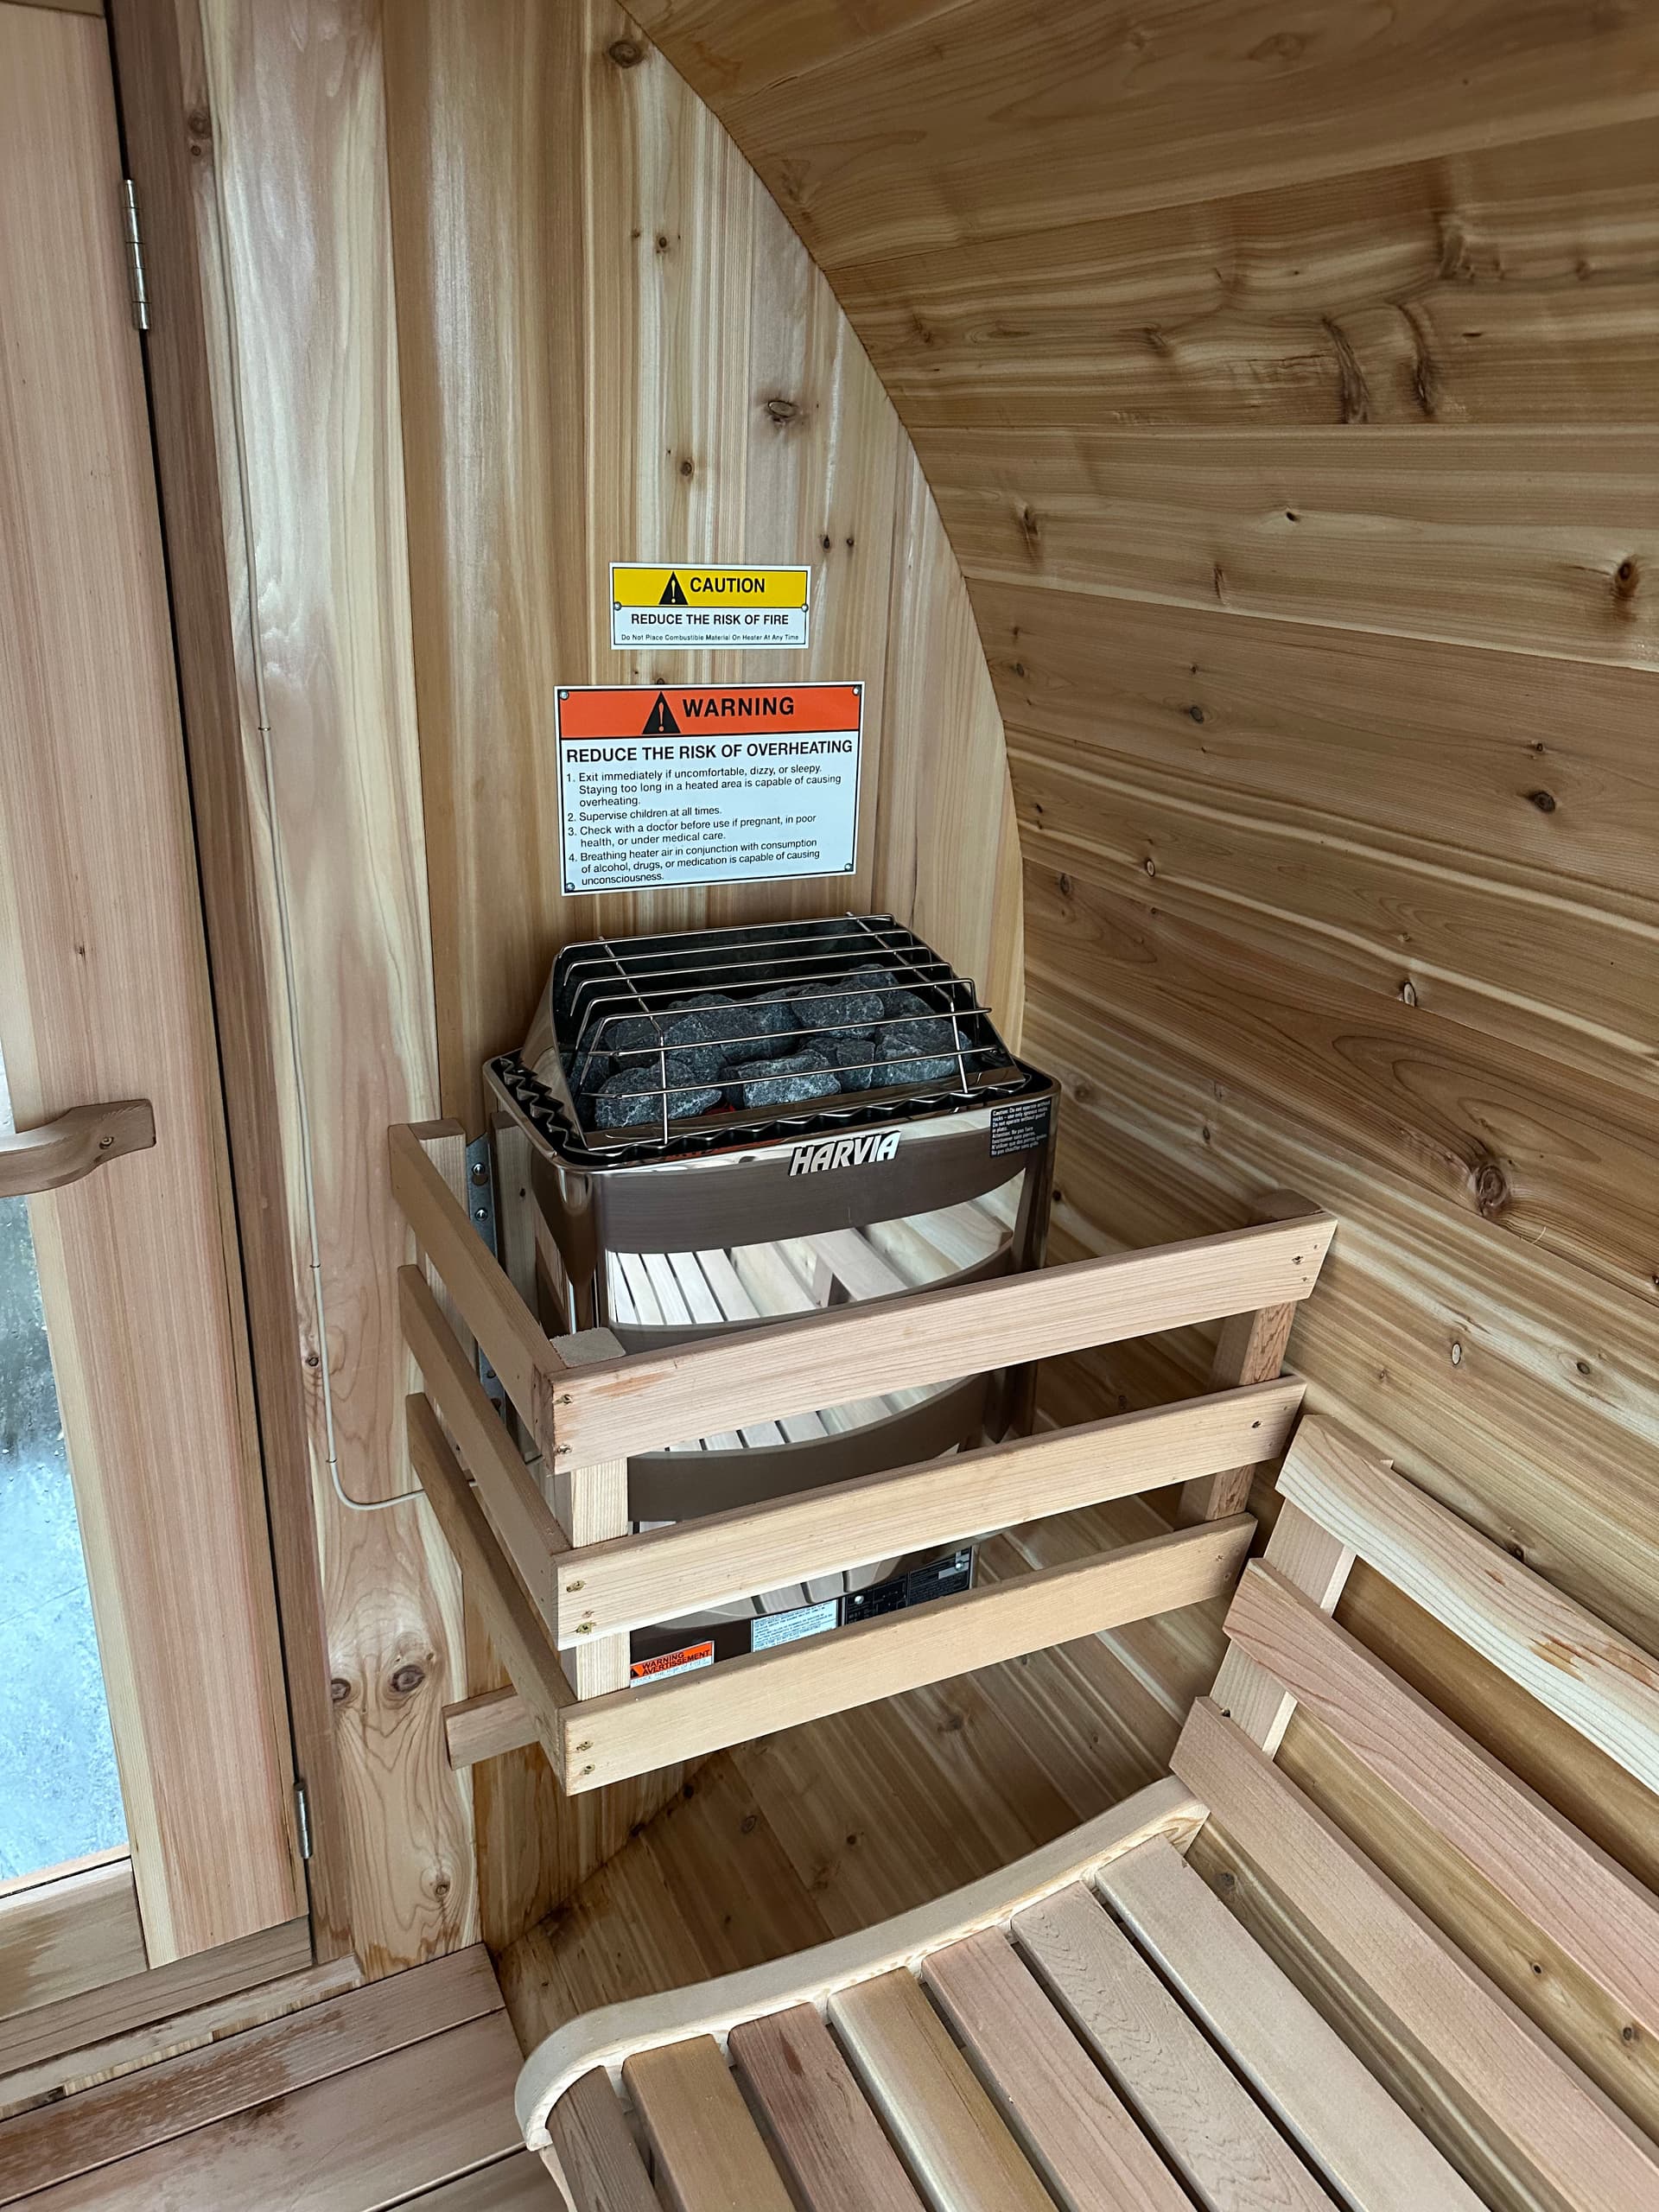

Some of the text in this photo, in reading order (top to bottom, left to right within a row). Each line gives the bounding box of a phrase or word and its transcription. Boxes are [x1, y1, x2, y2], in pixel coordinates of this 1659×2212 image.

[690, 577, 766, 594] CAUTION
[631, 614, 789, 625] REDUCE THE RISK OF FIRE
[683, 696, 795, 717] WARNING
[566, 740, 853, 763] REDUCE THE RISK OF OVERHEATING
[566, 764, 822, 782] 1. Exit immediately if uncomfortable, dizzy, or sleepy.
[579, 785, 618, 796] Staying
[620, 784, 637, 792] too
[640, 783, 662, 793] long
[685, 779, 718, 790] heated
[721, 780, 742, 789] area
[745, 779, 753, 787] is
[755, 776, 792, 788] capable
[794, 775, 804, 785] of
[806, 775, 842, 785] causing
[579, 797, 640, 807] overheating.
[568, 806, 721, 823] 2. Supervise children at all times.
[568, 827, 577, 836] 3.
[580, 825, 612, 836] Check
[614, 823, 635, 833] with
[646, 822, 678, 831] doctor
[680, 819, 710, 830] before
[732, 818, 739, 827] if
[740, 816, 783, 828] pregnant,
[785, 815, 793, 823] in
[796, 815, 817, 824] poor
[581, 837, 614, 848] health,
[631, 835, 660, 845] under
[662, 832, 700, 843] medical
[702, 832, 726, 841] care.
[569, 853, 578, 862] 4.
[581, 850, 626, 861] Breathing
[629, 849, 658, 859] heater
[661, 848, 673, 856] air
[685, 843, 738, 856] conjunction
[741, 842, 759, 851] with
[760, 839, 817, 850] consumption
[582, 864, 591, 874] of
[594, 862, 631, 873] alcohol,
[633, 861, 663, 871] drugs,
[677, 855, 727, 867] medication
[729, 855, 737, 863] is
[739, 852, 774, 864] capable
[776, 851, 785, 861] of
[786, 849, 820, 860] causing
[582, 873, 664, 886] unconsciousness.
[789, 1130, 902, 1176] HARVIA
[642, 1651, 684, 1669] WARNING
[642, 1649, 710, 1676] AVERTISSEMENT
